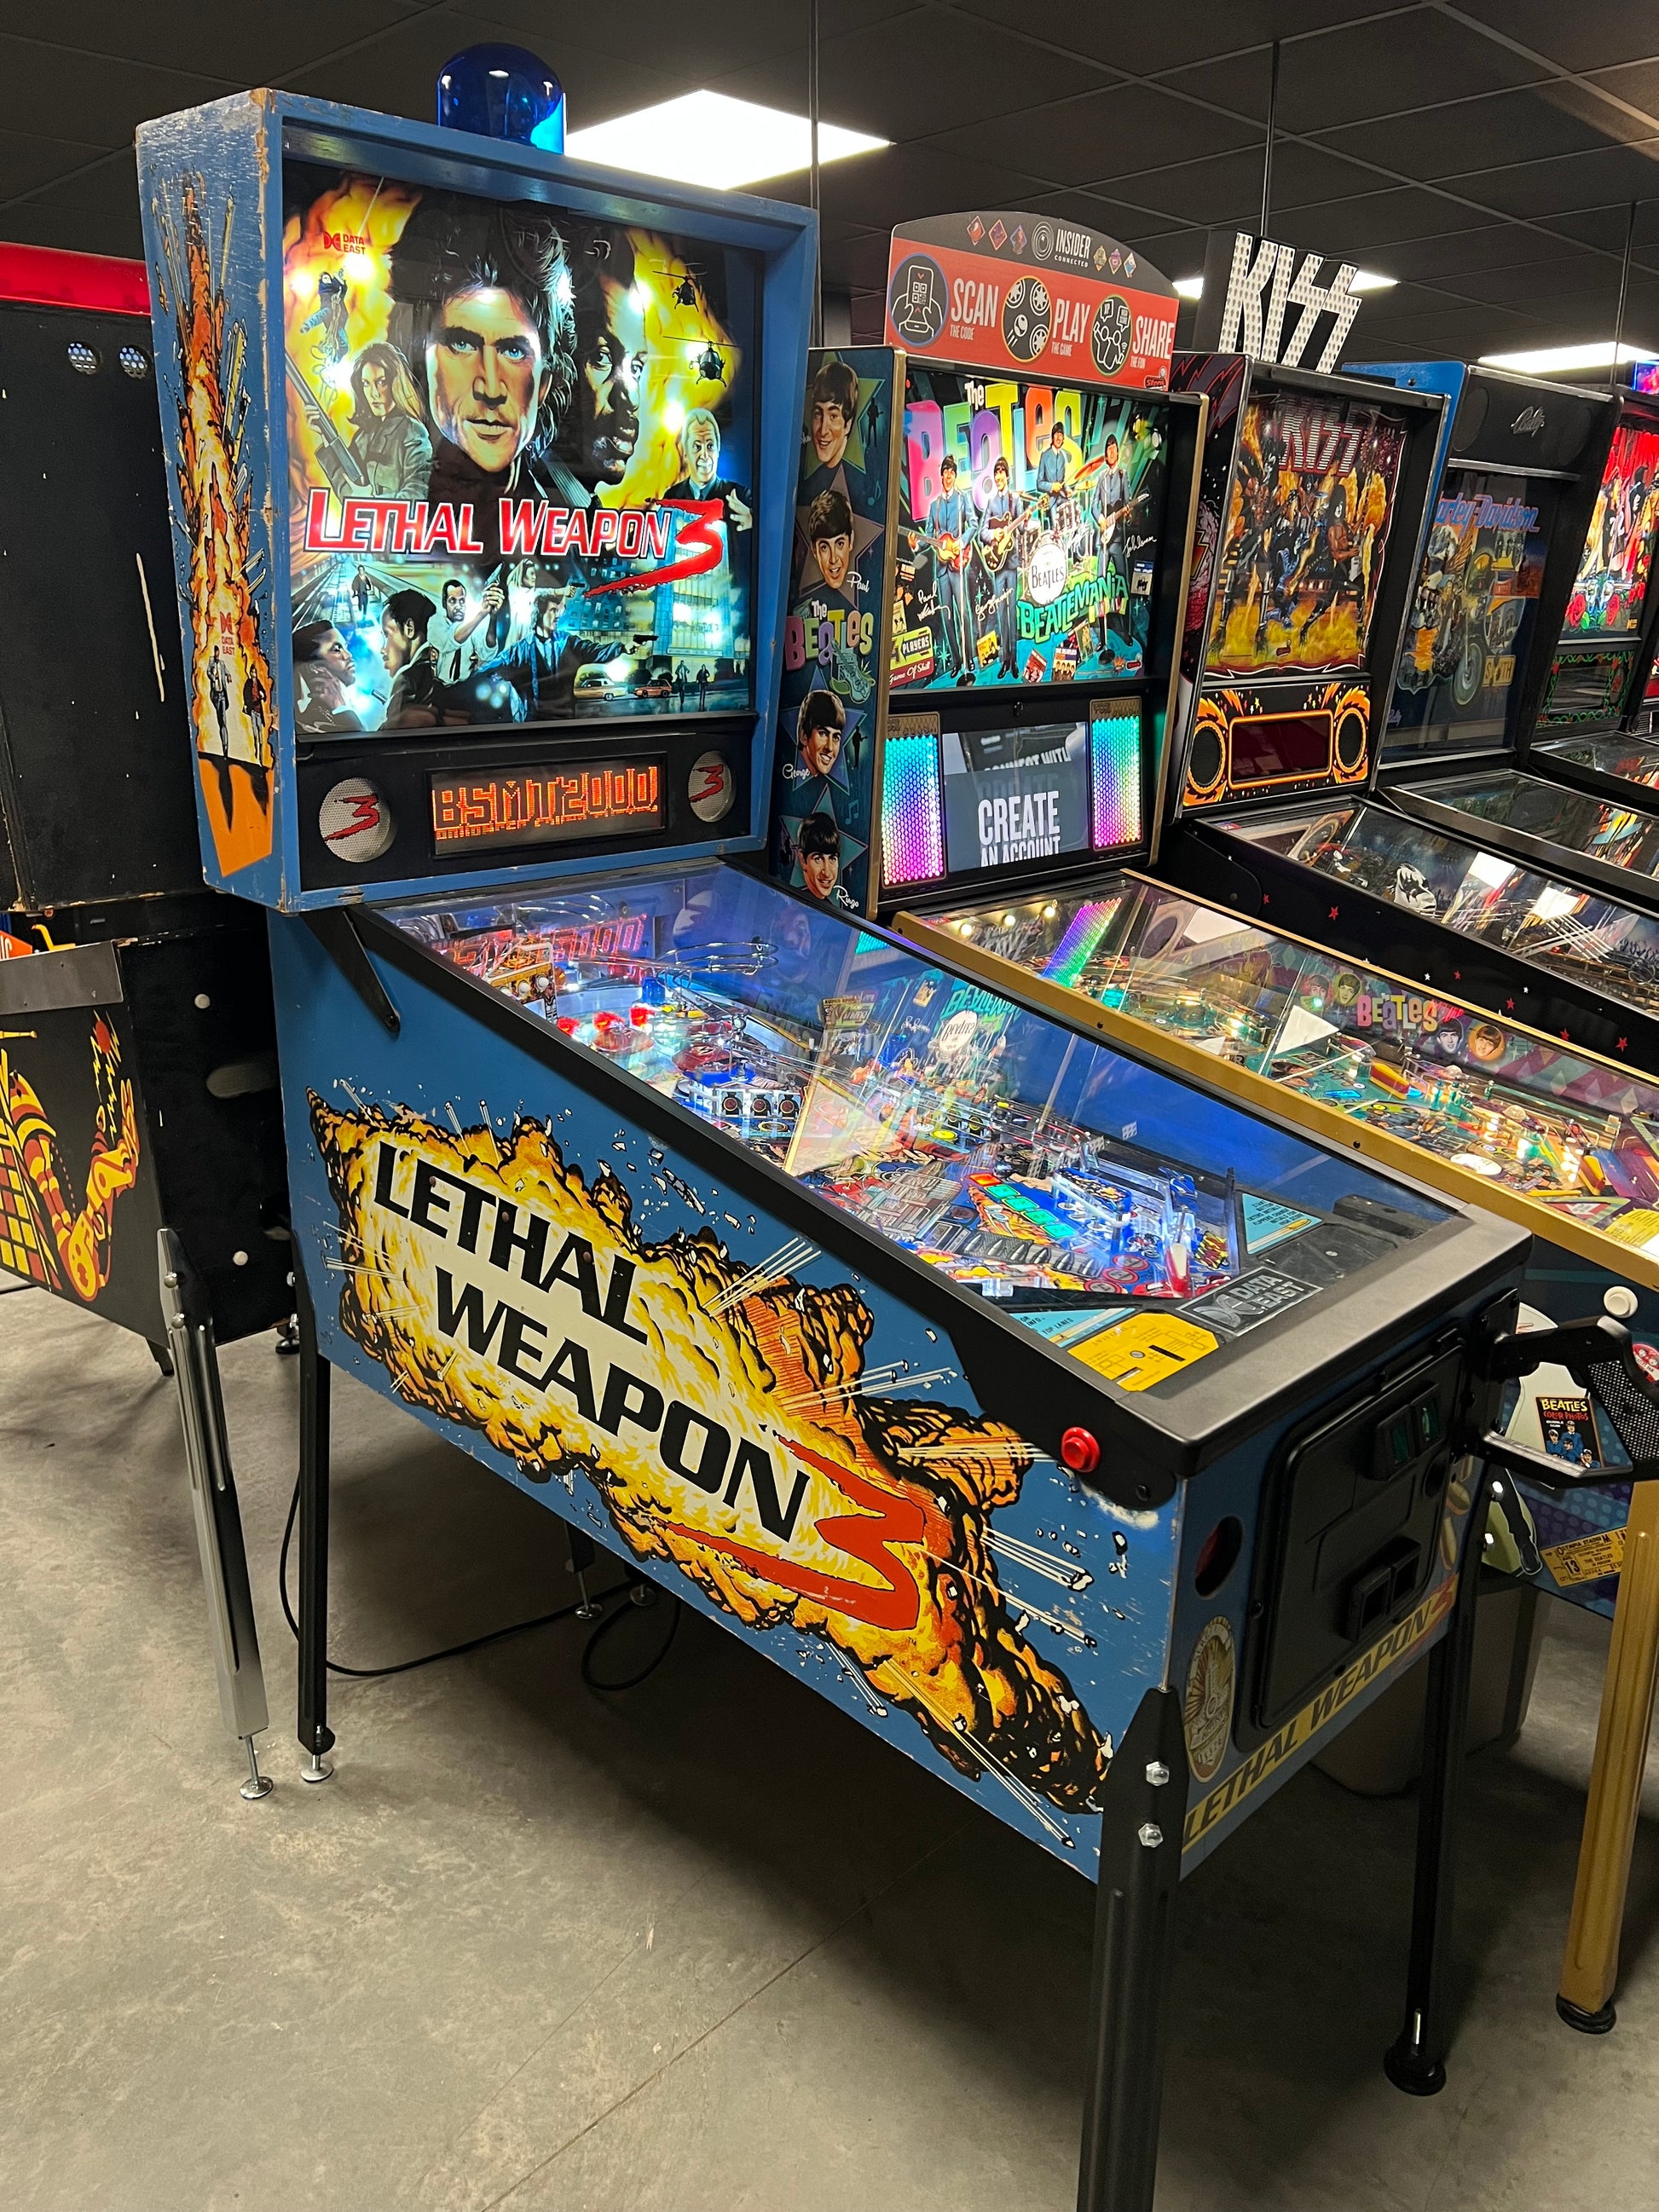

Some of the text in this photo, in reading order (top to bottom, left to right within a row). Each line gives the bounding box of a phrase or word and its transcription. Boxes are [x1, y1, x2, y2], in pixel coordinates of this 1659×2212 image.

[343, 234, 365, 245] DATA
[344, 244, 367, 255] EAST
[1055, 228, 1091, 259] INSIDER
[1054, 254, 1089, 269] CONNECTED
[1218, 232, 1362, 374] KISS
[951, 278, 1175, 360] SCAN PLAY SHARE
[950, 324, 974, 341] THE CODE
[1051, 341, 1072, 357] THE GAME
[965, 380, 986, 411] The
[1511, 406, 1546, 436] Bally
[1279, 396, 1362, 476] KISS
[1436, 492, 1540, 538] arley-Davidson
[305, 487, 725, 598] LETHAL WEAPON 3
[847, 571, 870, 593] Paul
[1032, 564, 1065, 589] BEATLES
[812, 600, 827, 621] The
[223, 645, 235, 656] EAST
[902, 637, 929, 655] PLAYERS
[689, 764, 724, 802] 3
[783, 764, 811, 779] George
[323, 794, 380, 842] 3
[979, 790, 1061, 846] CREATE
[833, 886, 859, 910] Ringo
[373, 1141, 649, 1344] LETHAL
[1228, 1273, 1282, 1300] DATA
[1254, 1281, 1305, 1308] EAST
[1042, 1326, 1054, 1335] TOP
[1054, 1317, 1074, 1329] LANES
[435, 1265, 811, 1542] WEAPON
[1541, 1399, 1588, 1412] BEATLES
[1543, 1411, 1588, 1422] COLOR PHOTOS
[660, 1431, 927, 1631] 3
[1557, 1542, 1581, 1556] OLYMPIA
[1582, 1534, 1612, 1545] STADIUM
[1594, 1553, 1614, 1562] BEATLES
[1565, 1560, 1581, 1574] 13
[1182, 1599, 1433, 1843] LETHAL WEAPON
